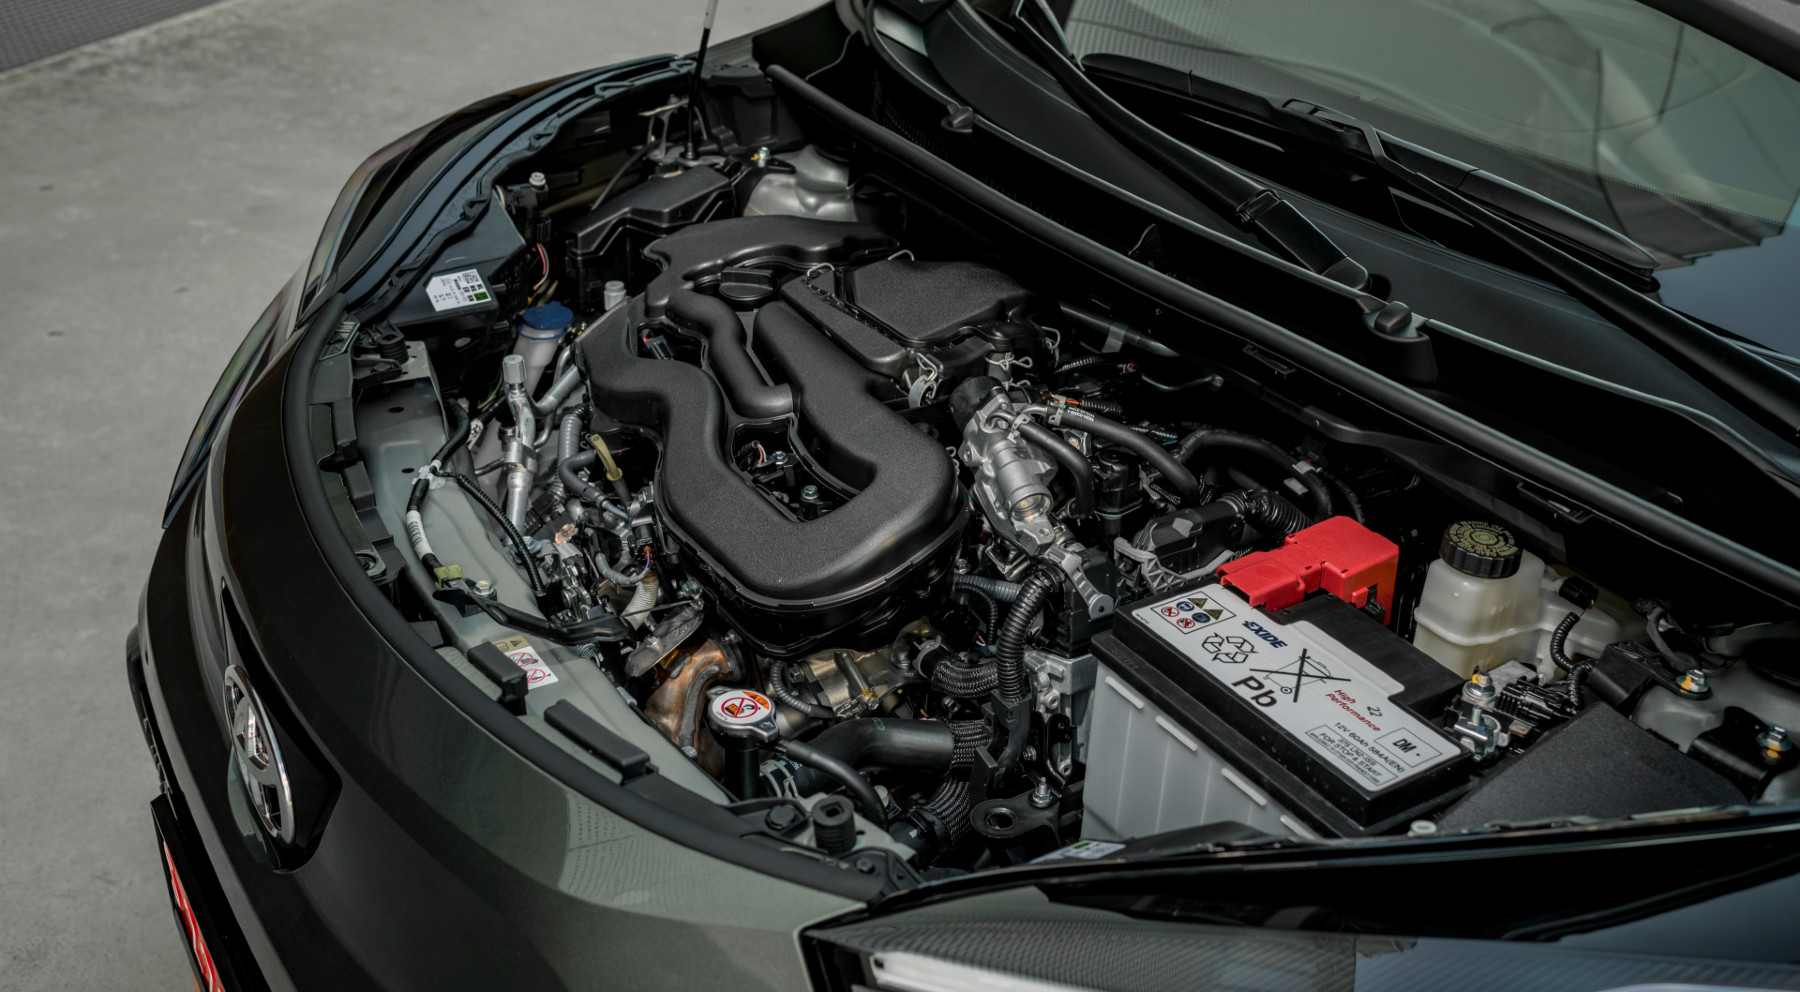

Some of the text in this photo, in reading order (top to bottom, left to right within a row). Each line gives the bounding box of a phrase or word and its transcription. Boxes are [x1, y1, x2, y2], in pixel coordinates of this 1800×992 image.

[1242, 620, 1288, 649] EXIDE
[1231, 676, 1277, 707] Pb
[1334, 689, 1356, 704] High
[1325, 693, 1381, 732] Performance
[1366, 705, 1383, 717] 22
[1334, 722, 1351, 733] 12V
[1348, 732, 1369, 748] 60Ah
[1392, 738, 1417, 753] DM
[1319, 732, 1336, 744] FOR
[1334, 743, 1354, 757] STOP
[1357, 760, 1383, 776] START
